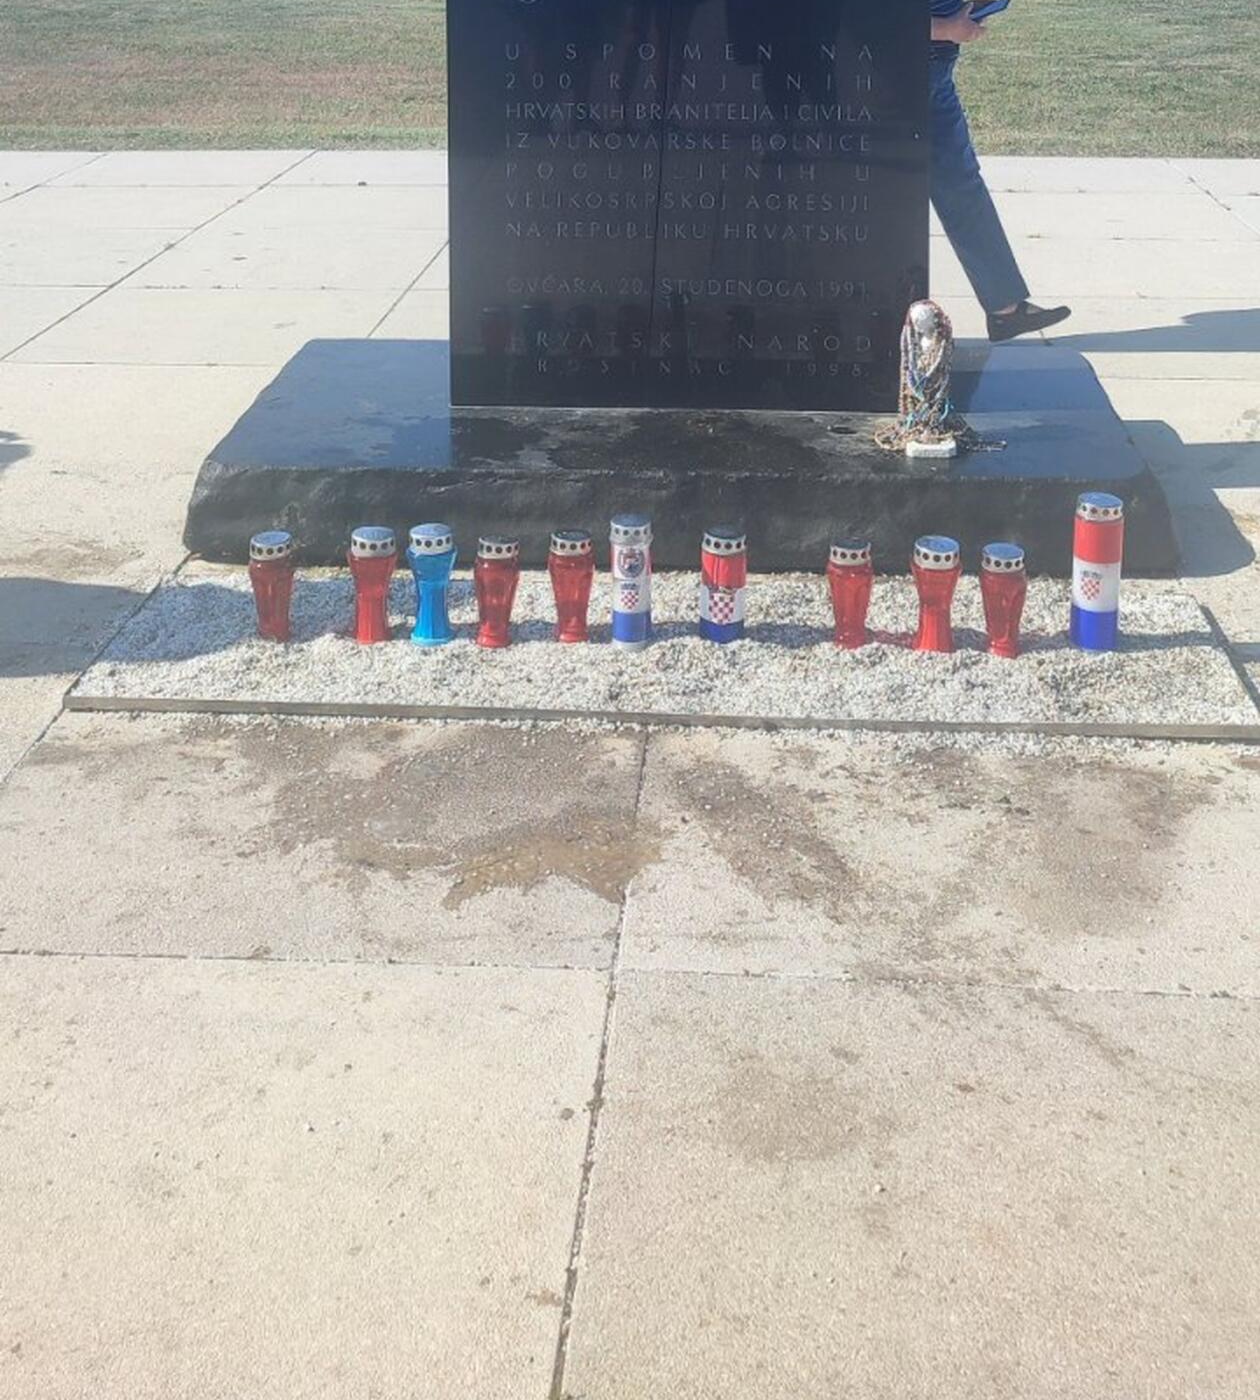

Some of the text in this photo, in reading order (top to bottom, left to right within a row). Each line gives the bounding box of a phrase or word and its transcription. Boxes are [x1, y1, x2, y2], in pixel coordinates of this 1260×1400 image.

[505, 43, 872, 60] U SPOMEN NA
[505, 72, 873, 91] 200 RANJENIH
[505, 102, 872, 122] HRVATSKIH BRANITELJA I CIVILA
[505, 132, 870, 151] IZ VUKOVARSKE BOLNICE
[854, 163, 870, 181] U
[505, 191, 869, 213] VELIKOSRPSKOJ AGRESIJI
[505, 222, 869, 240] NA REPUBLIKU HRVATSKU
[661, 278, 807, 297] STUDENOGA
[738, 333, 872, 352] NAROD
